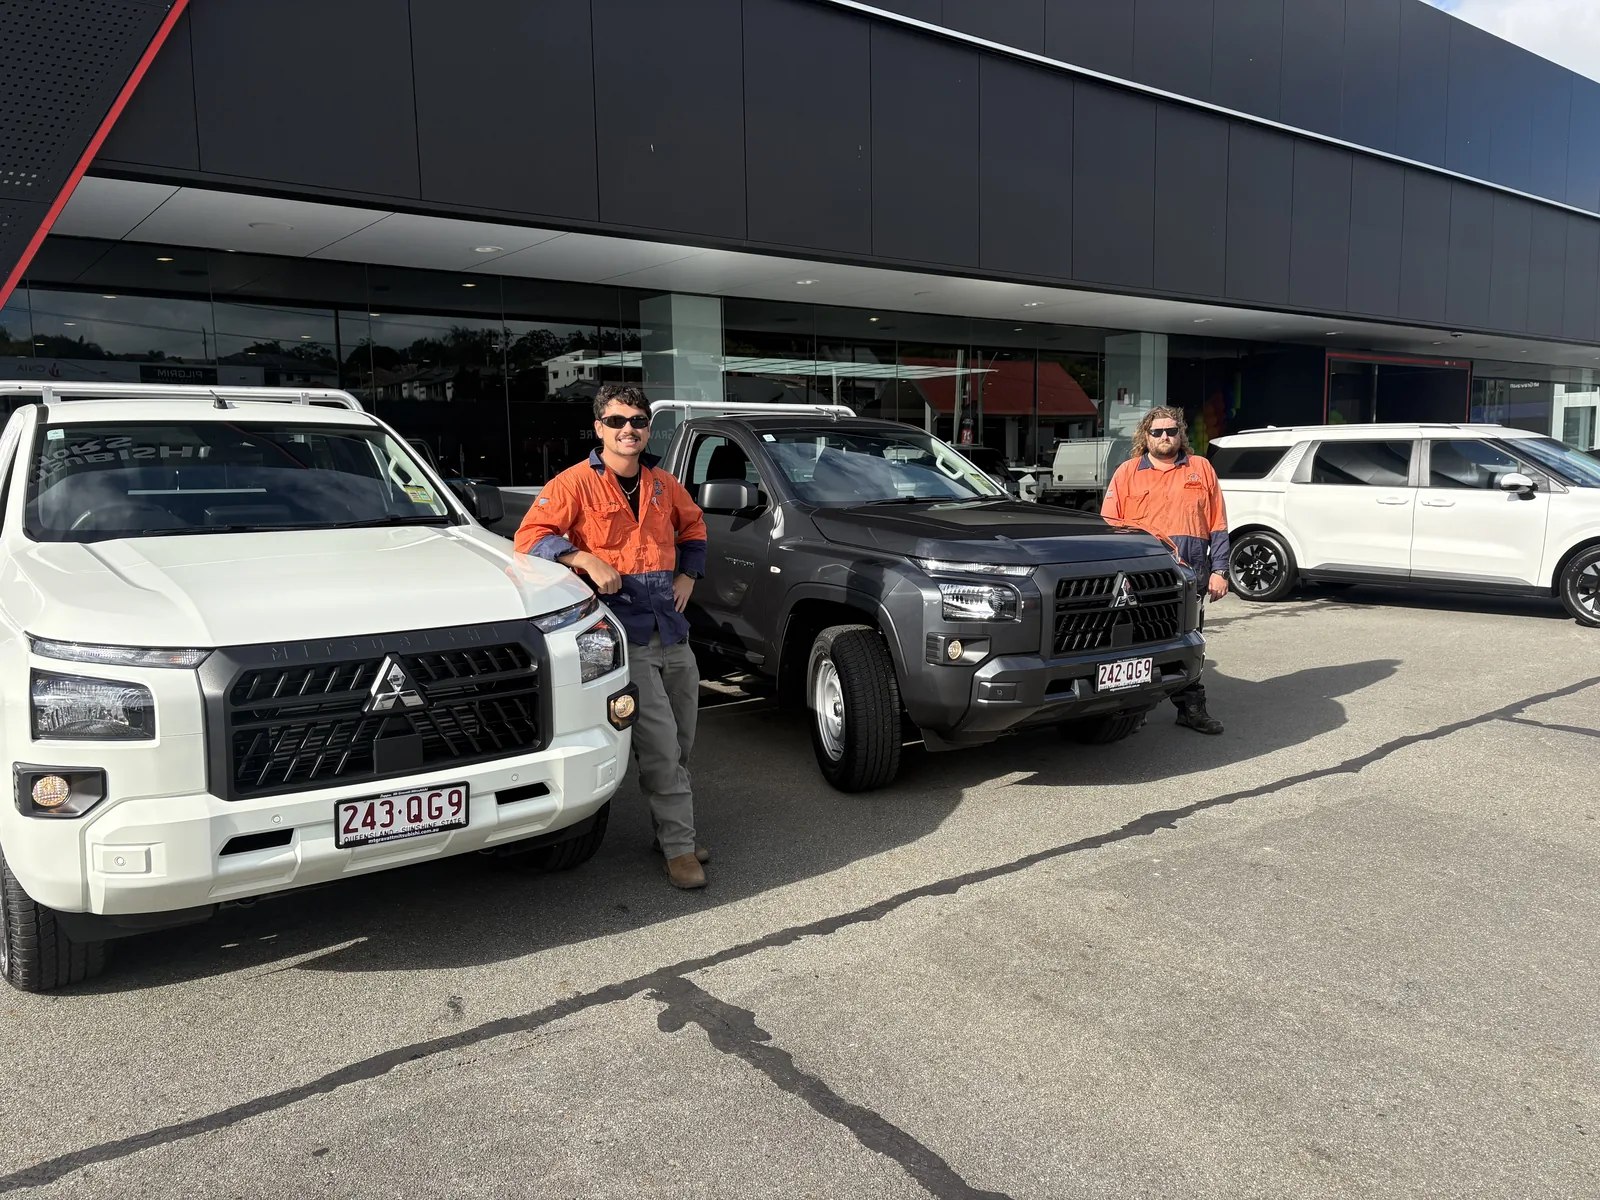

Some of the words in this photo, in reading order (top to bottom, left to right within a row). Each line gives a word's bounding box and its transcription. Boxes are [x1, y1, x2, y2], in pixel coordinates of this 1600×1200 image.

[271, 627, 499, 661] MITSUBISHI
[343, 829, 393, 843] QUEENSLAND
[401, 822, 437, 833] SUNSHINE
[440, 817, 462, 827] STATE
